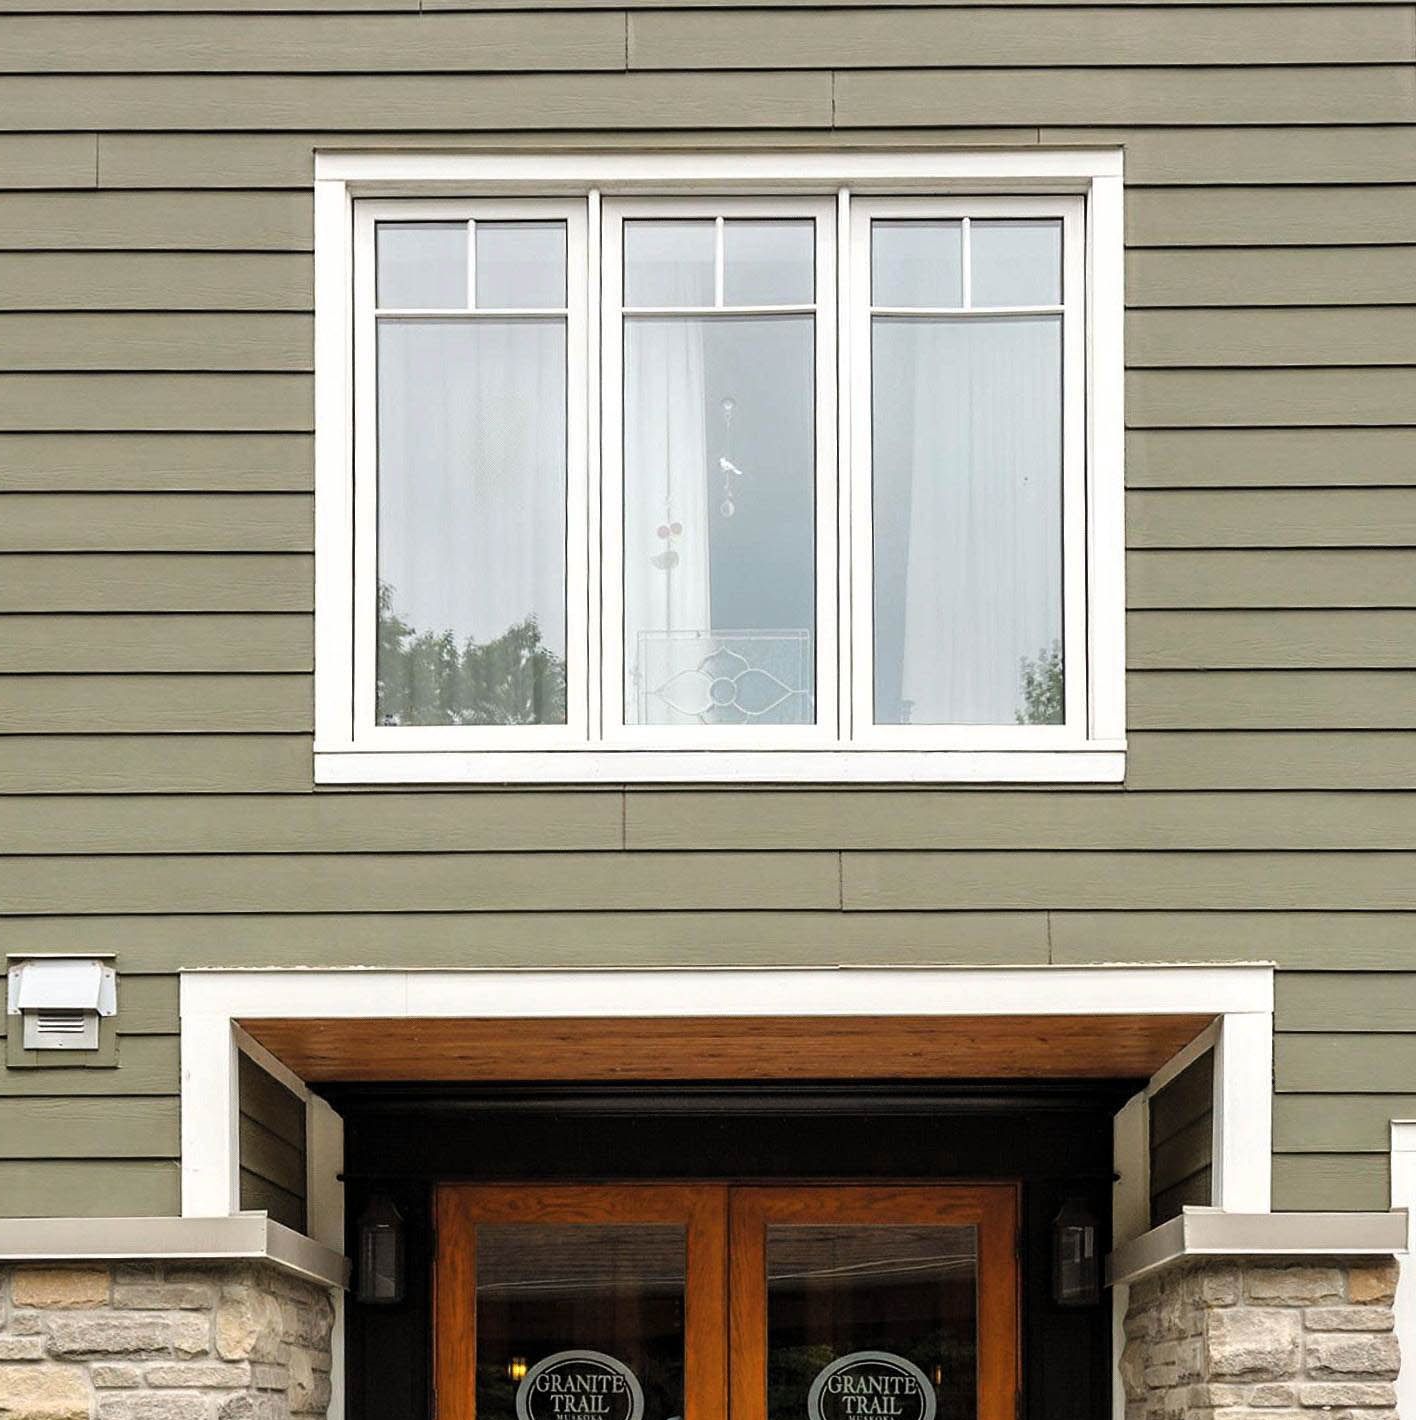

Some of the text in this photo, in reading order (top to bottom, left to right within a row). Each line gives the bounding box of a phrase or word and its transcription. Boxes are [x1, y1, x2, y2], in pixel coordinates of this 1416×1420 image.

[535, 1373, 625, 1393] GRANITE
[827, 1375, 917, 1395] GRANITE
[550, 1394, 610, 1413] TRAIL
[842, 1395, 903, 1415] TRAIL
